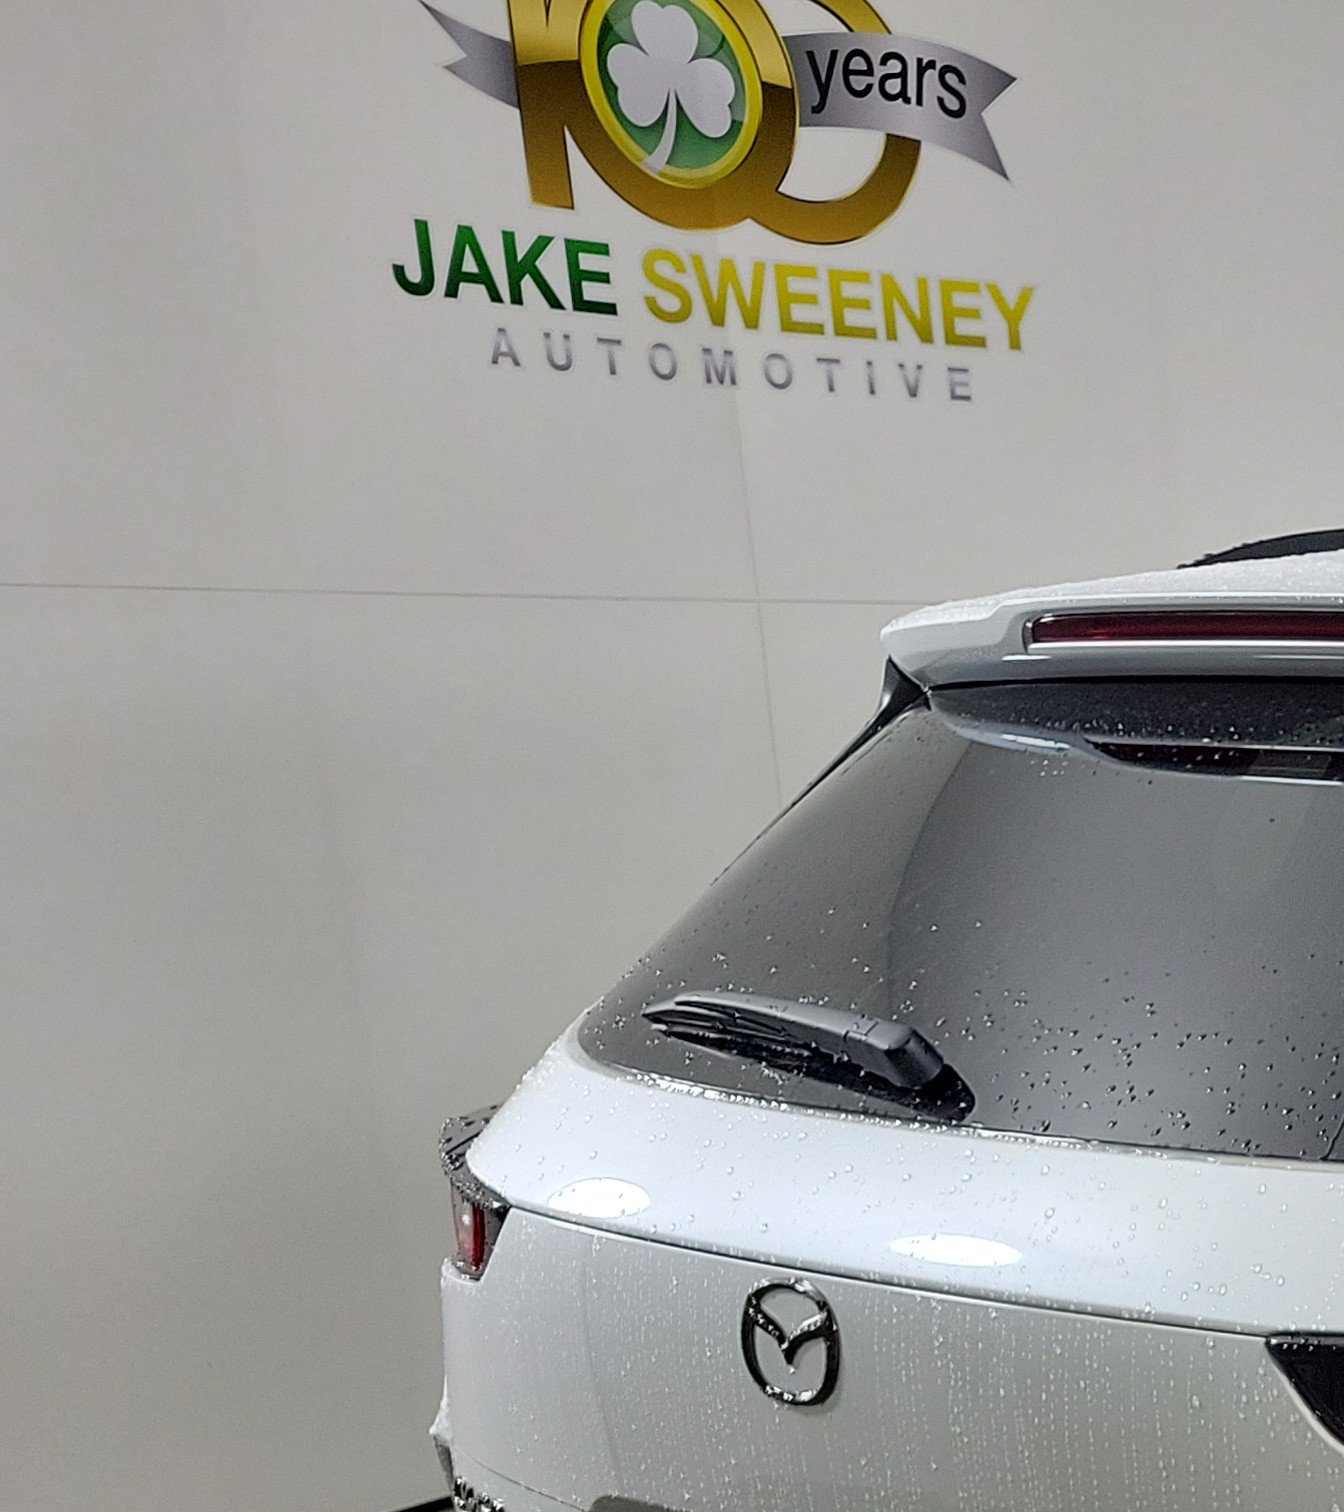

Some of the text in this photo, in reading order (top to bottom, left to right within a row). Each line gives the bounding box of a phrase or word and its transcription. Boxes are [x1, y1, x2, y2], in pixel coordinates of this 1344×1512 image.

[805, 44, 969, 120] years
[391, 217, 1035, 351] JAKE SWEENEY
[489, 326, 973, 402] AUTOMOTIVE
